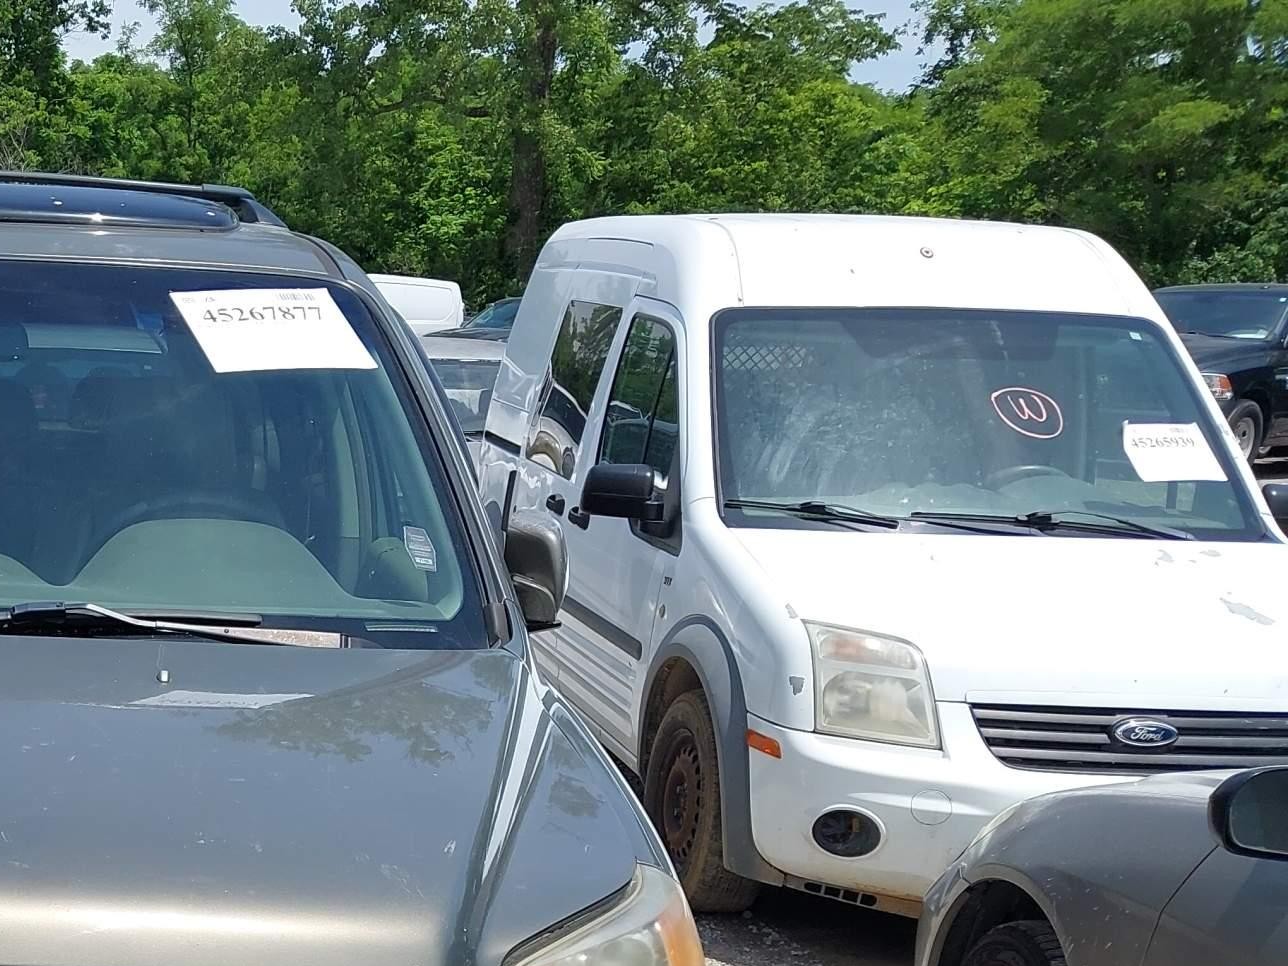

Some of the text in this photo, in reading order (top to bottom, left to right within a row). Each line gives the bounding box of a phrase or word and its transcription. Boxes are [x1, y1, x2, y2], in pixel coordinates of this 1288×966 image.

[202, 305, 322, 323] 45267877
[1007, 394, 1047, 423] W
[1130, 436, 1196, 449] 45265939
[1130, 726, 1165, 741] Ford
